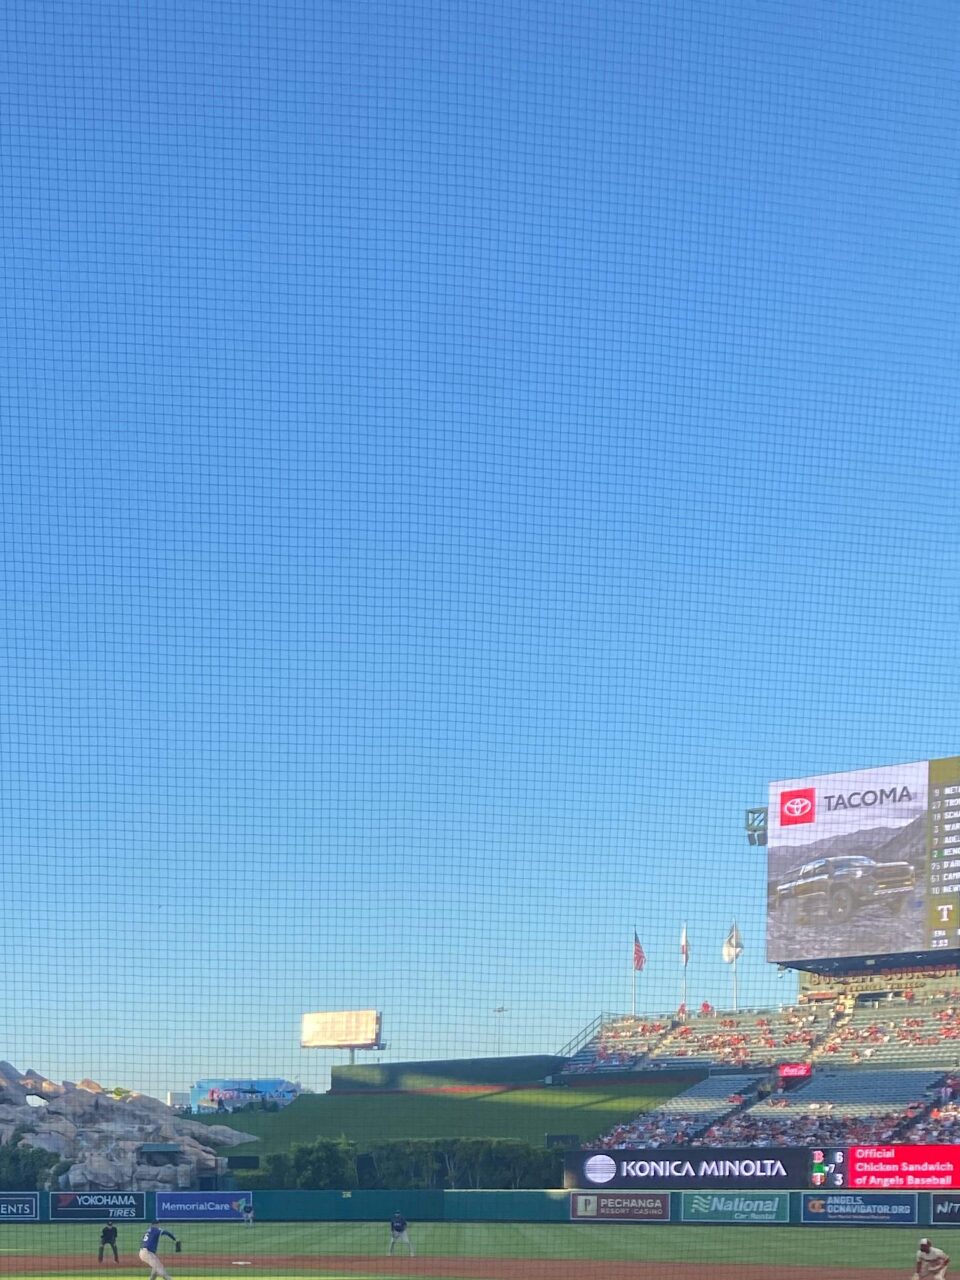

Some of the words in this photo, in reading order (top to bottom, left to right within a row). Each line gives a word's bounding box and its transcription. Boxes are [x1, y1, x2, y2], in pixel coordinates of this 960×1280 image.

[824, 786, 912, 811] TACOMA
[938, 905, 953, 921] T
[835, 1152, 844, 1163] 6
[855, 1149, 895, 1159] Official
[622, 1160, 696, 1177] KONICA
[700, 1160, 788, 1177] MINOLTA
[855, 1162, 899, 1172] Chicken
[901, 1162, 954, 1172] Sandwich
[834, 1174, 844, 1186] 3
[854, 1175, 868, 1185] of
[869, 1175, 904, 1187] Angels
[906, 1175, 952, 1185] Baseball
[76, 1195, 137, 1206] YOKOHAMA
[600, 1198, 663, 1208] PECHANGA
[710, 1197, 780, 1212] National
[161, 1201, 231, 1212] MemorialCare
[827, 1205, 911, 1214] OCNAVIGATOR.ORG
[108, 1208, 137, 1217] TIRES
